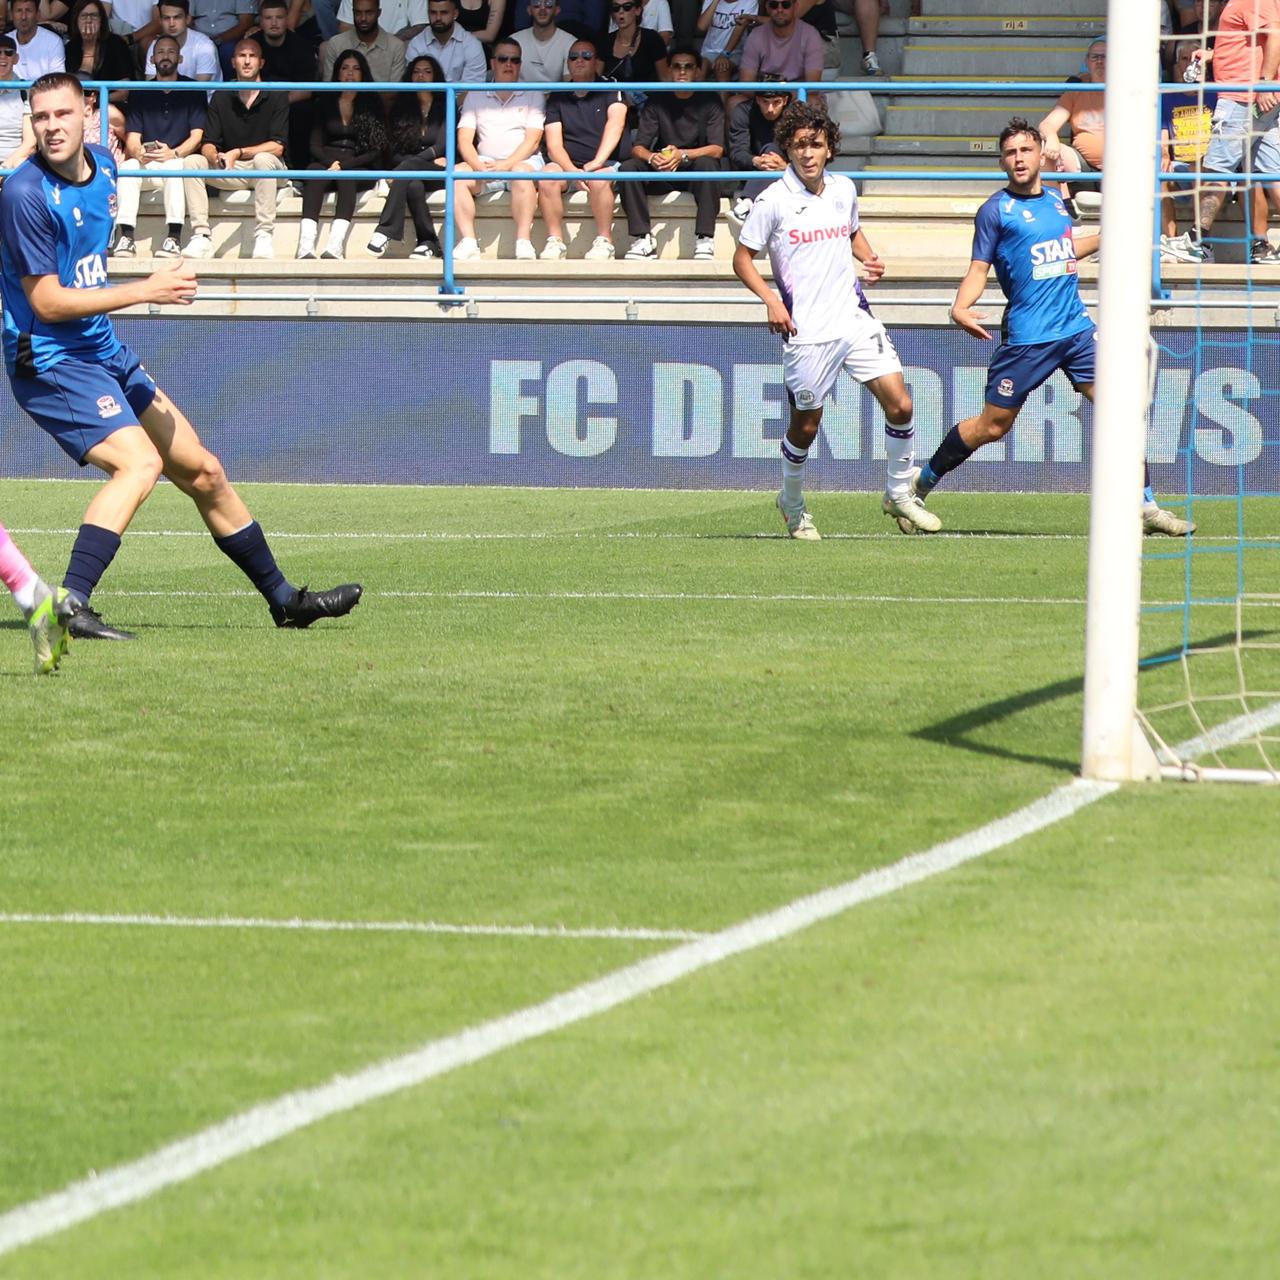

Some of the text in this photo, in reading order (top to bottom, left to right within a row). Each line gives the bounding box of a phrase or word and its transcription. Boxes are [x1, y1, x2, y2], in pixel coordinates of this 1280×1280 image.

[788, 223, 852, 245] Sunwe
[1031, 237, 1076, 266] STAR
[73, 254, 107, 289] STA
[490, 360, 618, 458] FC
